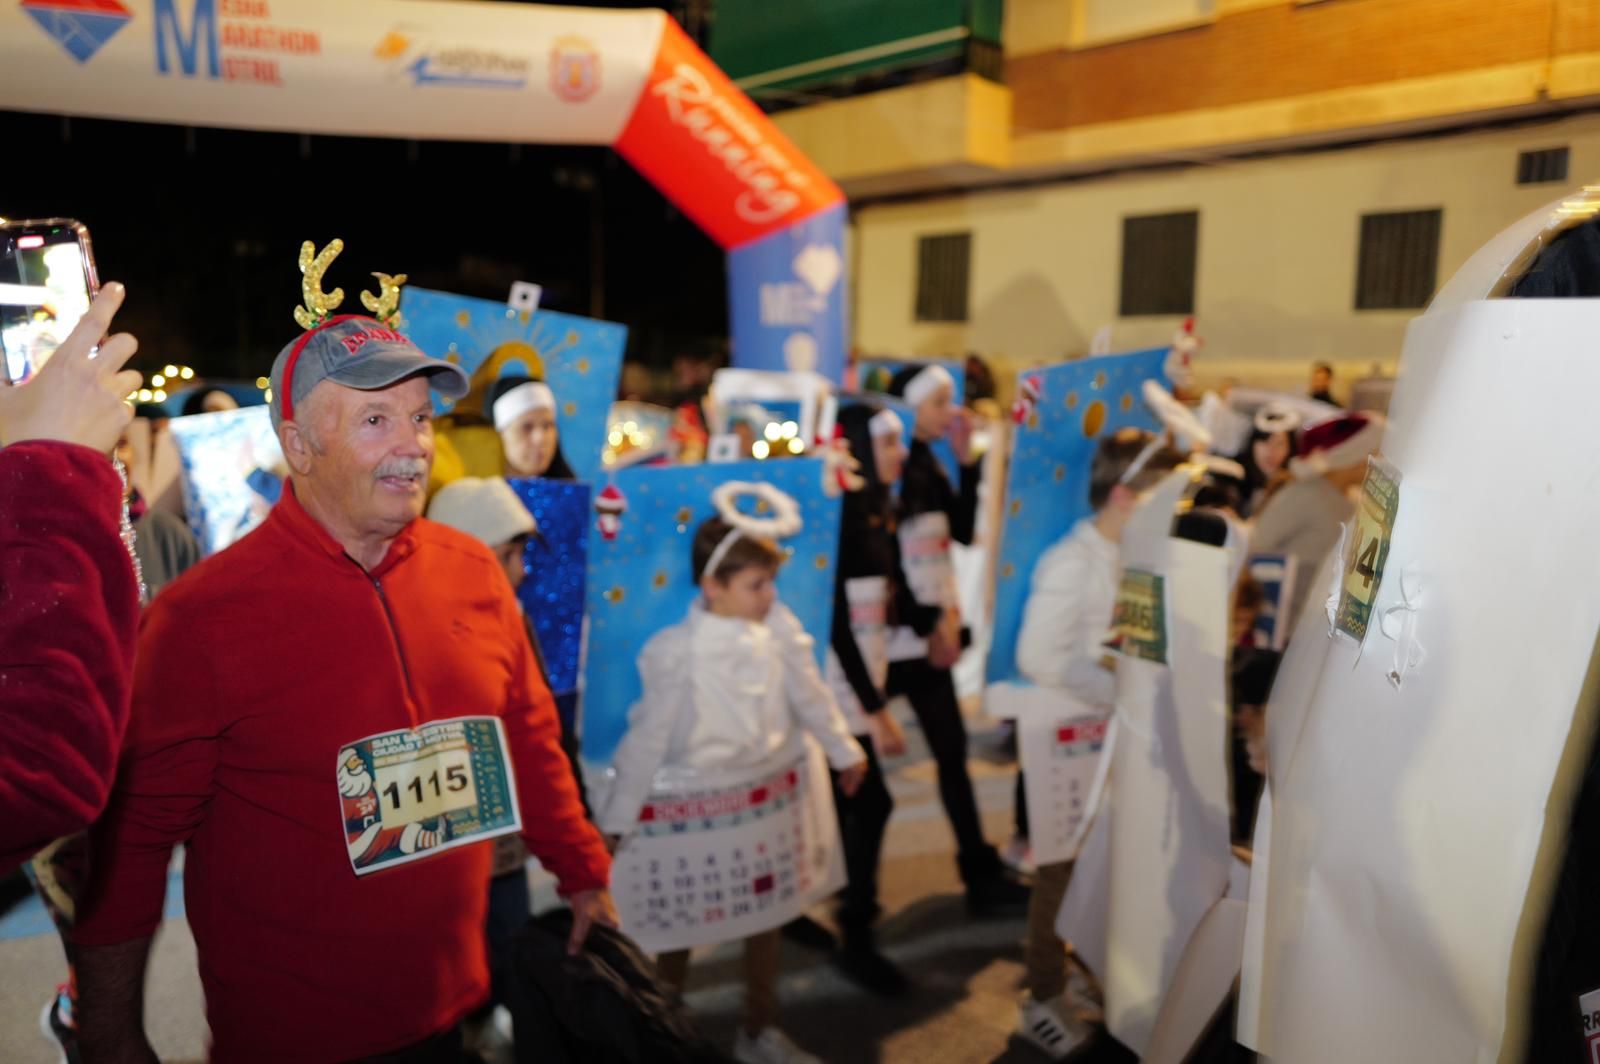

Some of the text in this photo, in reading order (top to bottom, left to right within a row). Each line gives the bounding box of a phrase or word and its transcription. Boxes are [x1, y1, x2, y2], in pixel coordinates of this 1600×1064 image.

[371, 735, 401, 749] SAN
[373, 742, 412, 757] CIUDAD
[383, 764, 467, 809] 1115
